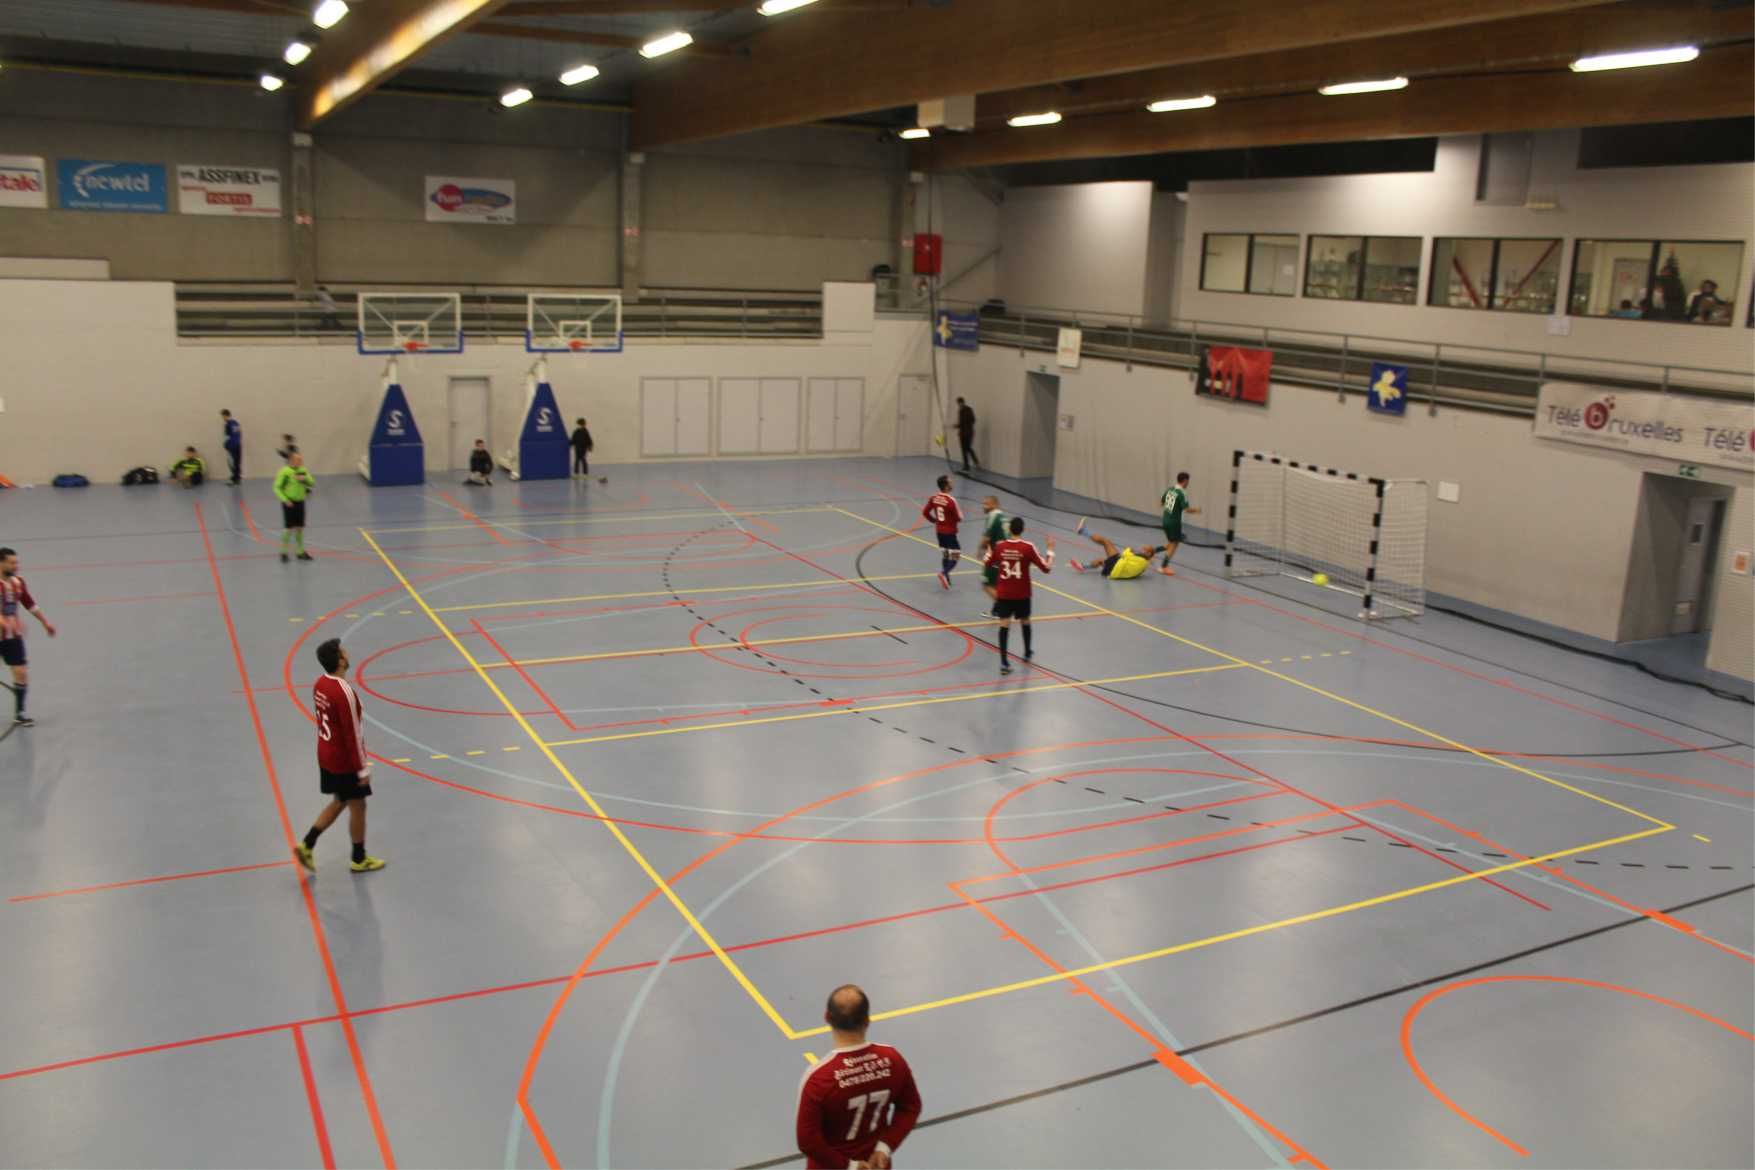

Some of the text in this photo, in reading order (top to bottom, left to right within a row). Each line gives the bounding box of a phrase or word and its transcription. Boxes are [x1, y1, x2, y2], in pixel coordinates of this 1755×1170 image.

[199, 168, 261, 185] ASSFINEX
[1548, 405, 1581, 428] Télé
[1704, 426, 1746, 451] Télé
[1000, 561, 1022, 579] 34
[846, 1089, 891, 1141] 77
